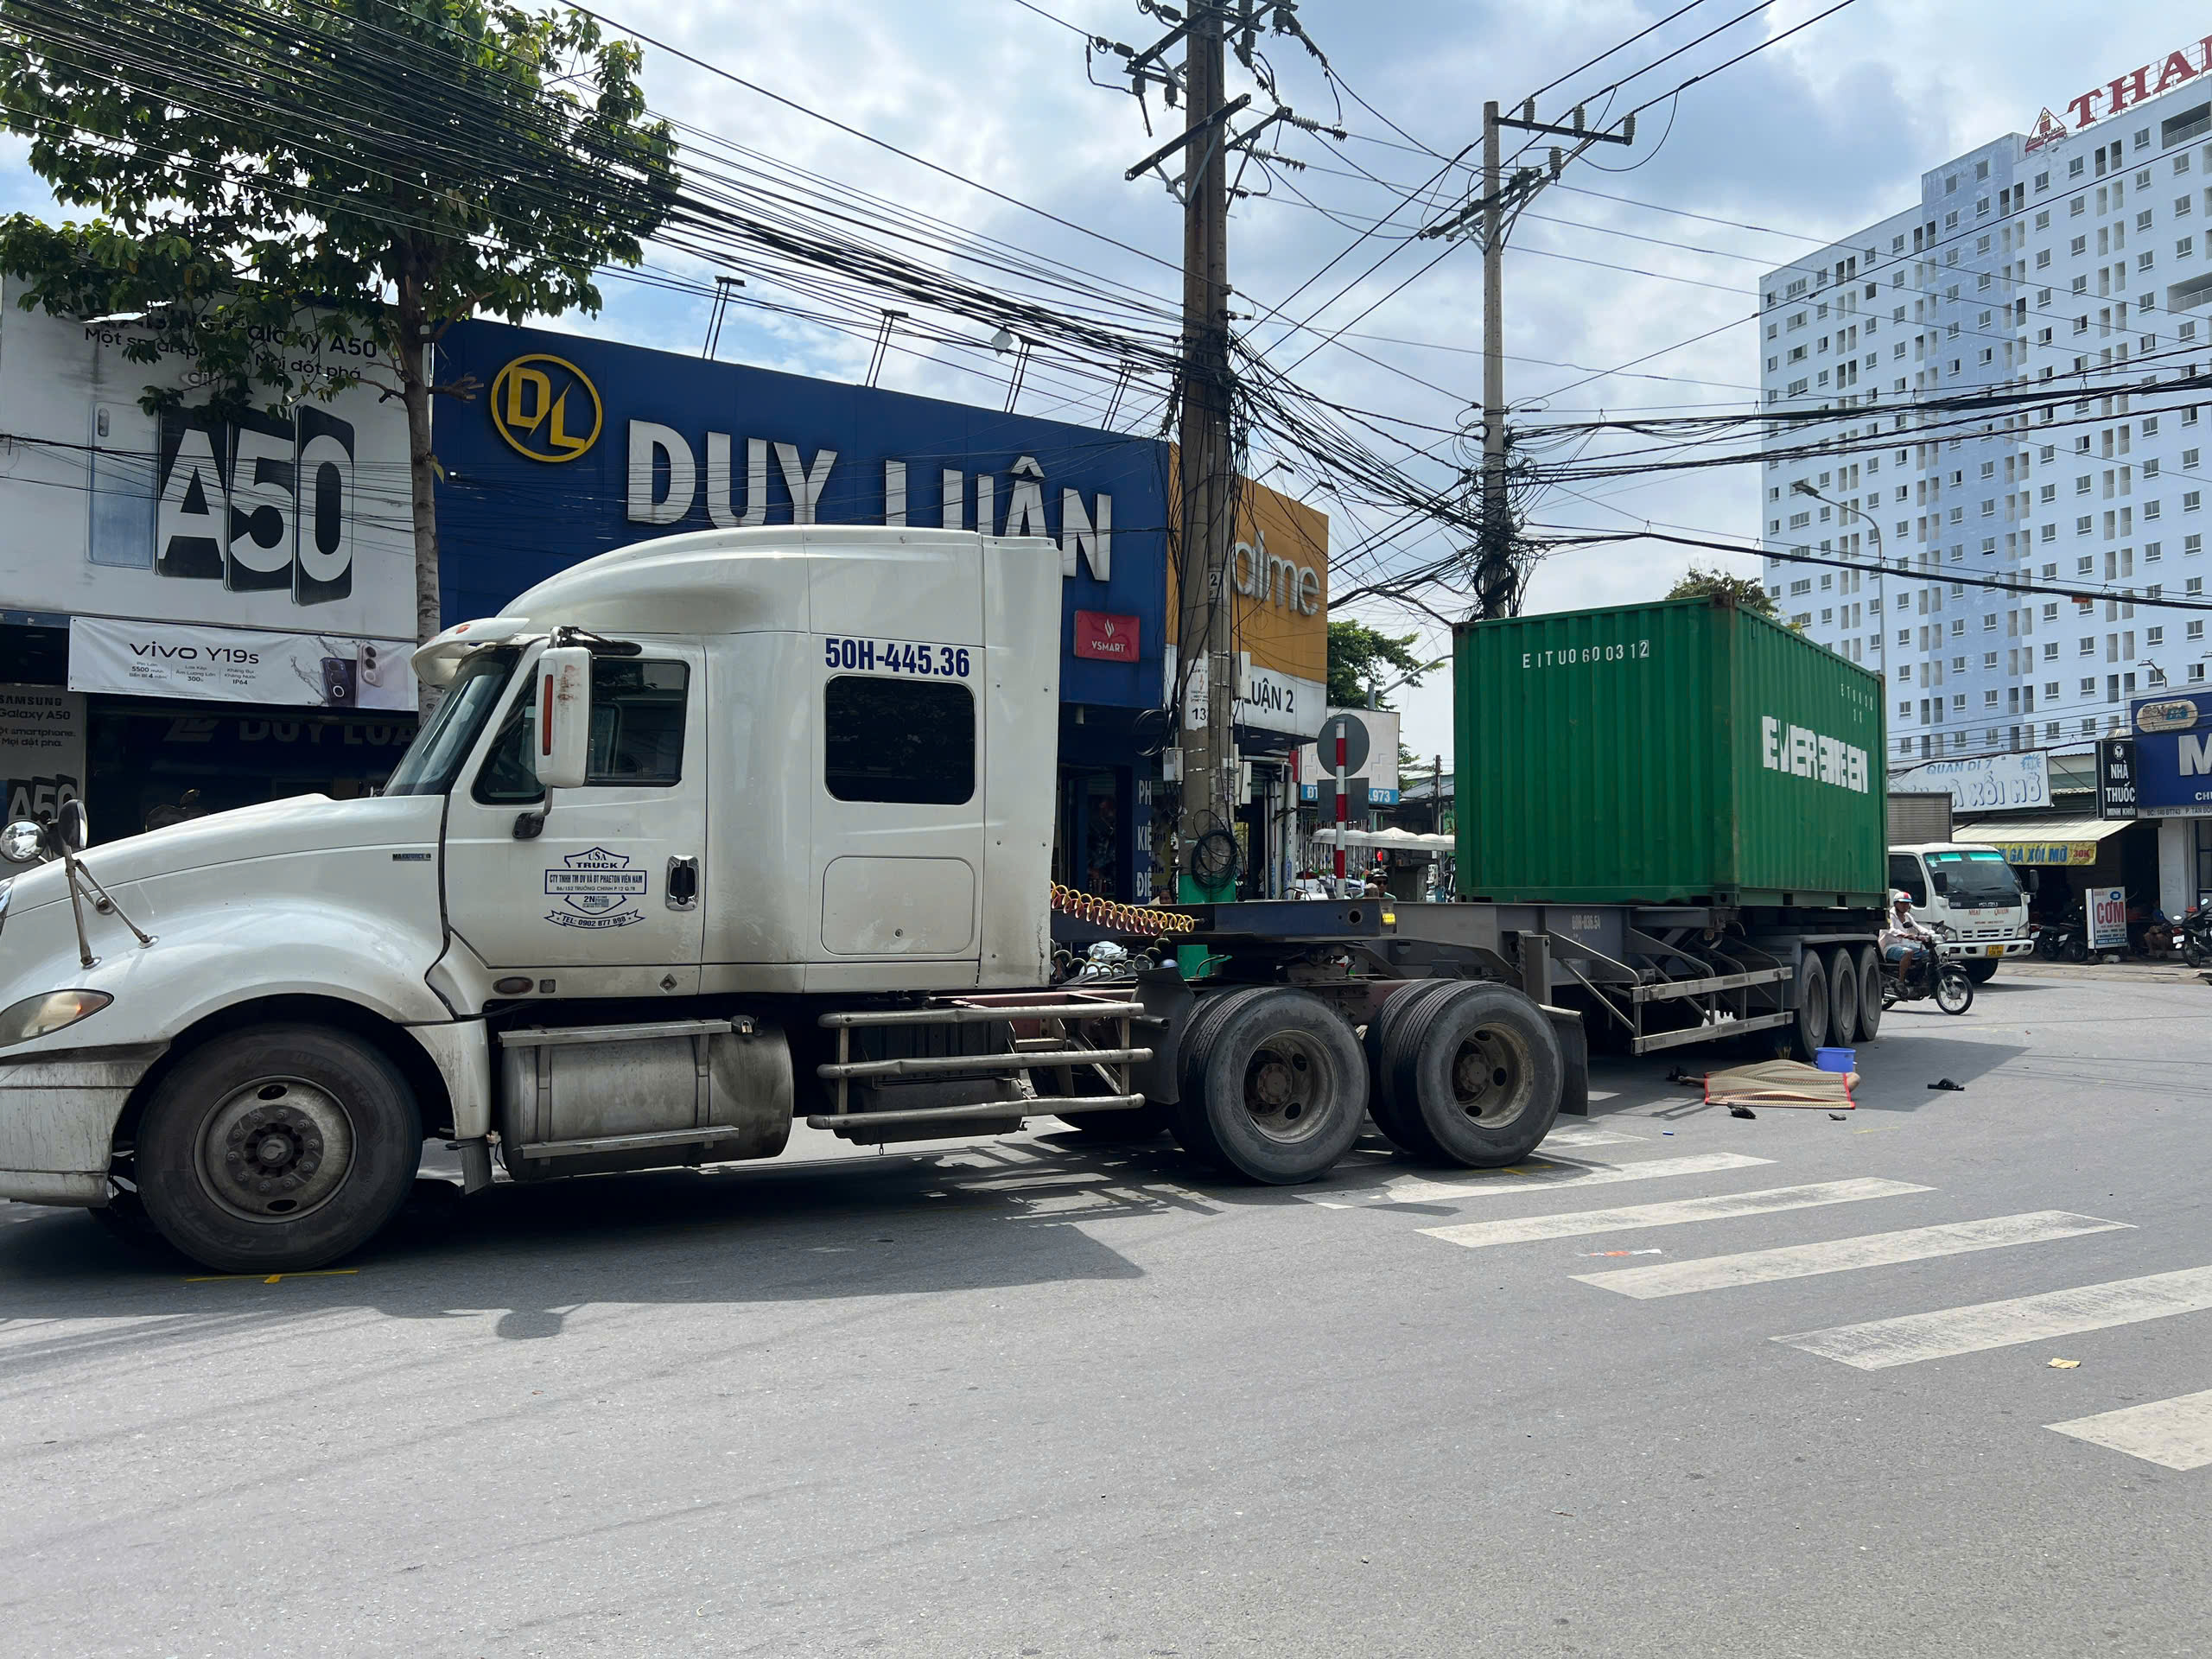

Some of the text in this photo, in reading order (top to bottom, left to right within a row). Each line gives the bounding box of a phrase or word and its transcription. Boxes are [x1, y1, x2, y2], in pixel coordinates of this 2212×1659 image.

[85, 327, 122, 348] Một
[329, 335, 377, 359] A50
[628, 418, 838, 531] DUY
[158, 428, 353, 583] A50
[1231, 530, 1320, 616] alme
[130, 641, 260, 664] vivo Y19s
[825, 638, 970, 677] 50H-445.36
[1091, 640, 1125, 653] VSMART
[0, 695, 62, 706] SAMSUNG
[1286, 690, 1294, 713] 2
[0, 708, 71, 721] Galaxy A50
[1762, 715, 1869, 794] EVERGREEN
[2110, 760, 2129, 779] NHÀ
[1138, 780, 1152, 805] PH
[1369, 789, 1390, 803] .973
[2106, 781, 2136, 803] THUỐC
[1137, 821, 1153, 857] KIỆ
[588, 852, 607, 861] USA
[1136, 866, 1153, 902] ĐIỆ
[562, 916, 577, 925] TEL:
[2096, 899, 2125, 925] CƠM
